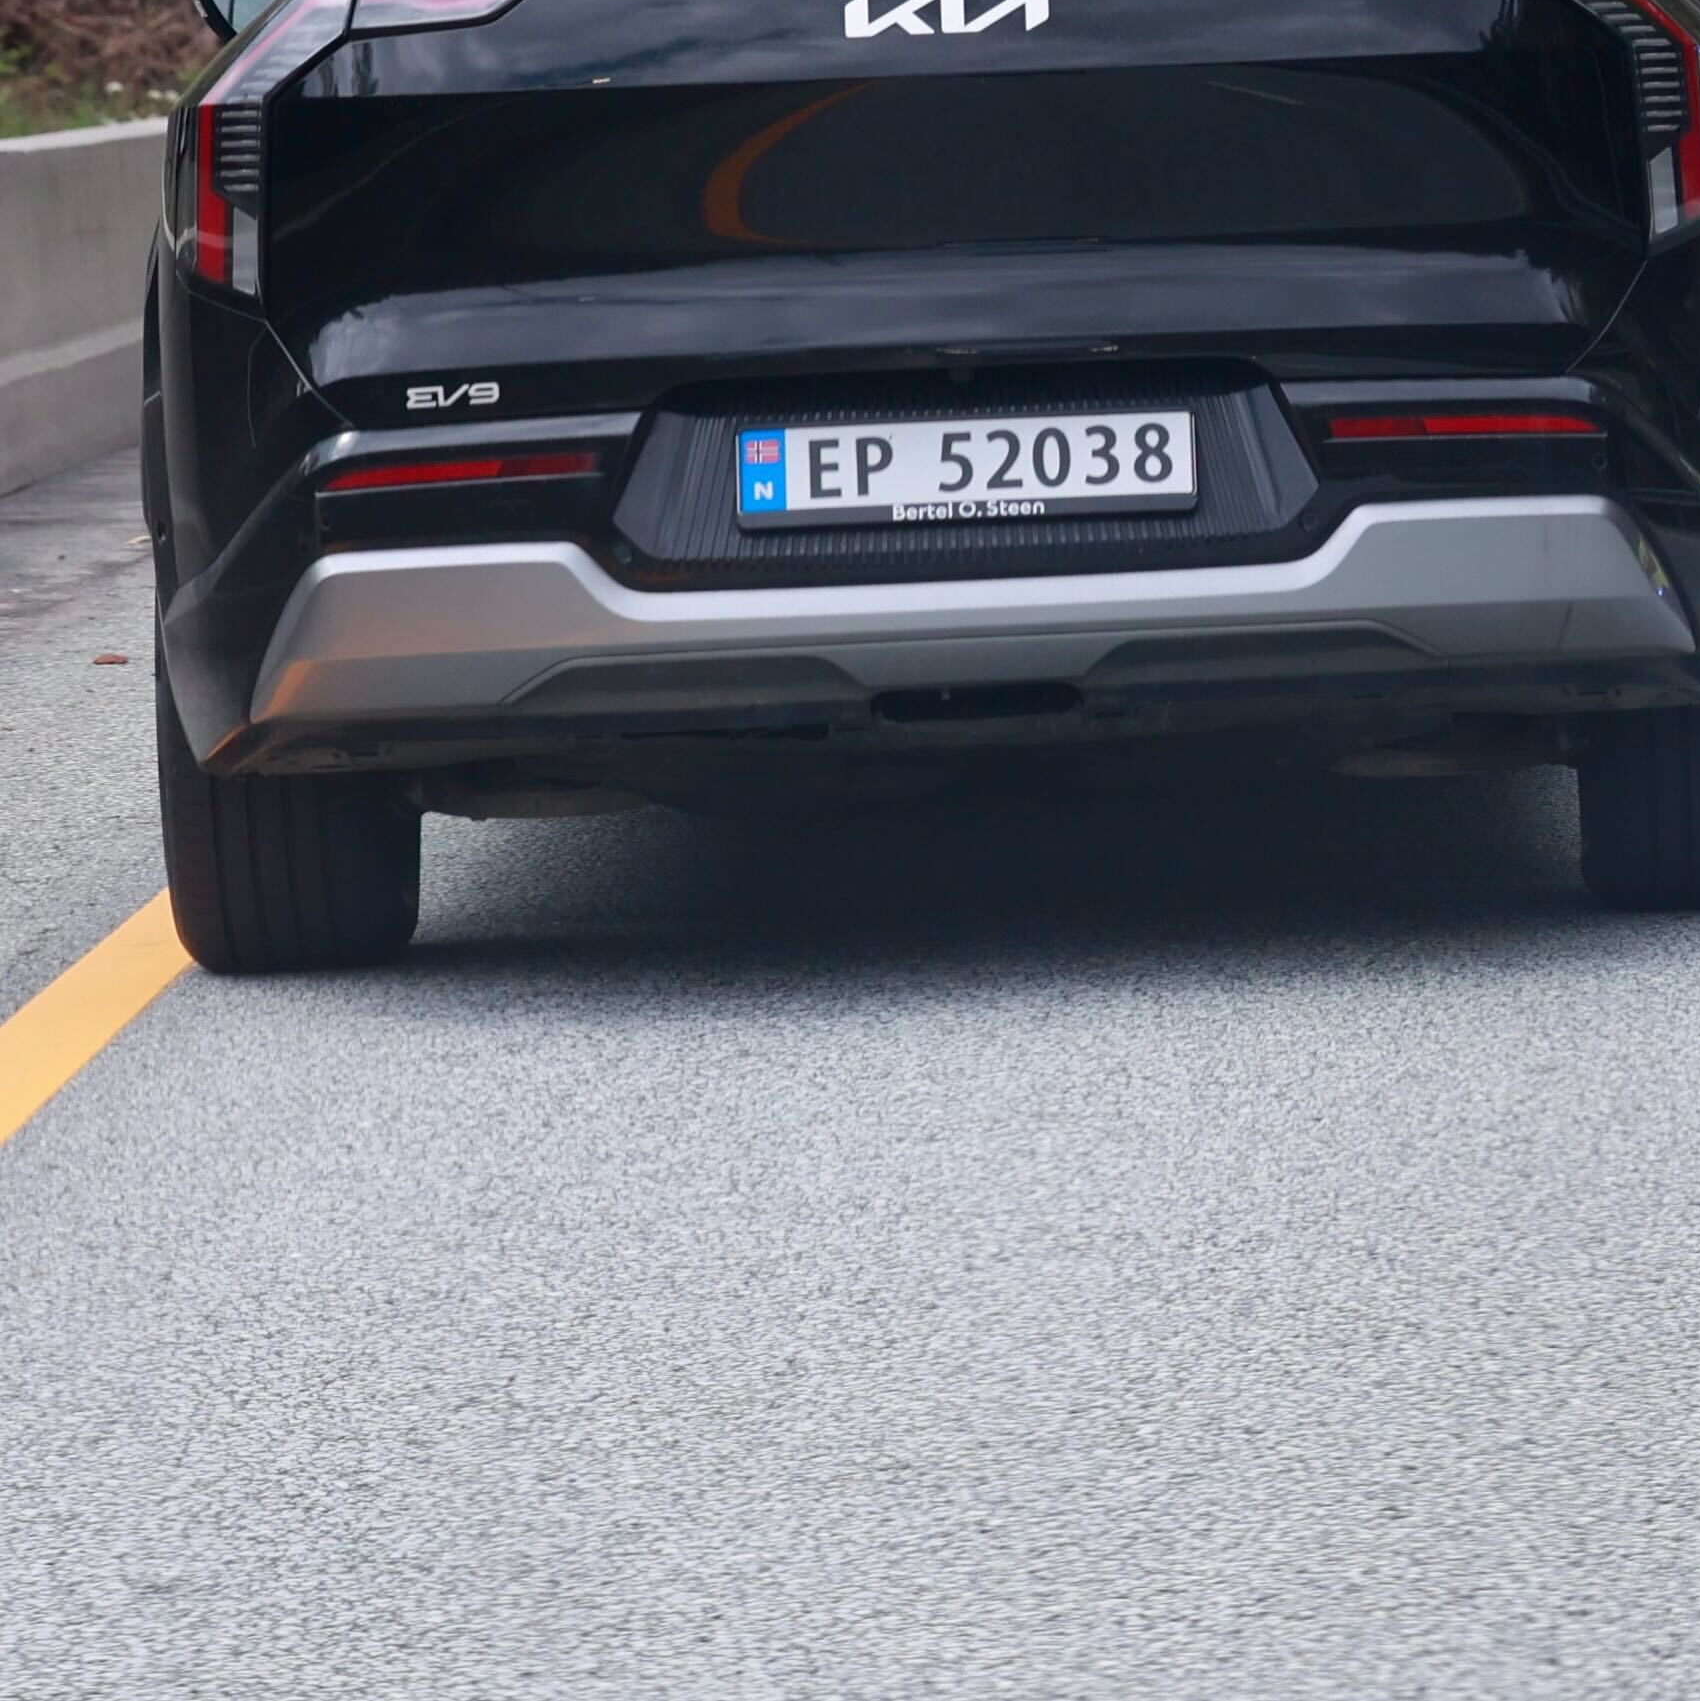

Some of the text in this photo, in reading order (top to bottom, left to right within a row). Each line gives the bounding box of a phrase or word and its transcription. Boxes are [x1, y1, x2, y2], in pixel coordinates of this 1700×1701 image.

[406, 382, 499, 409] EV9
[808, 423, 1173, 499] EP 52038
[754, 481, 773, 500] N
[893, 500, 1045, 521] Bertel O. Steen
